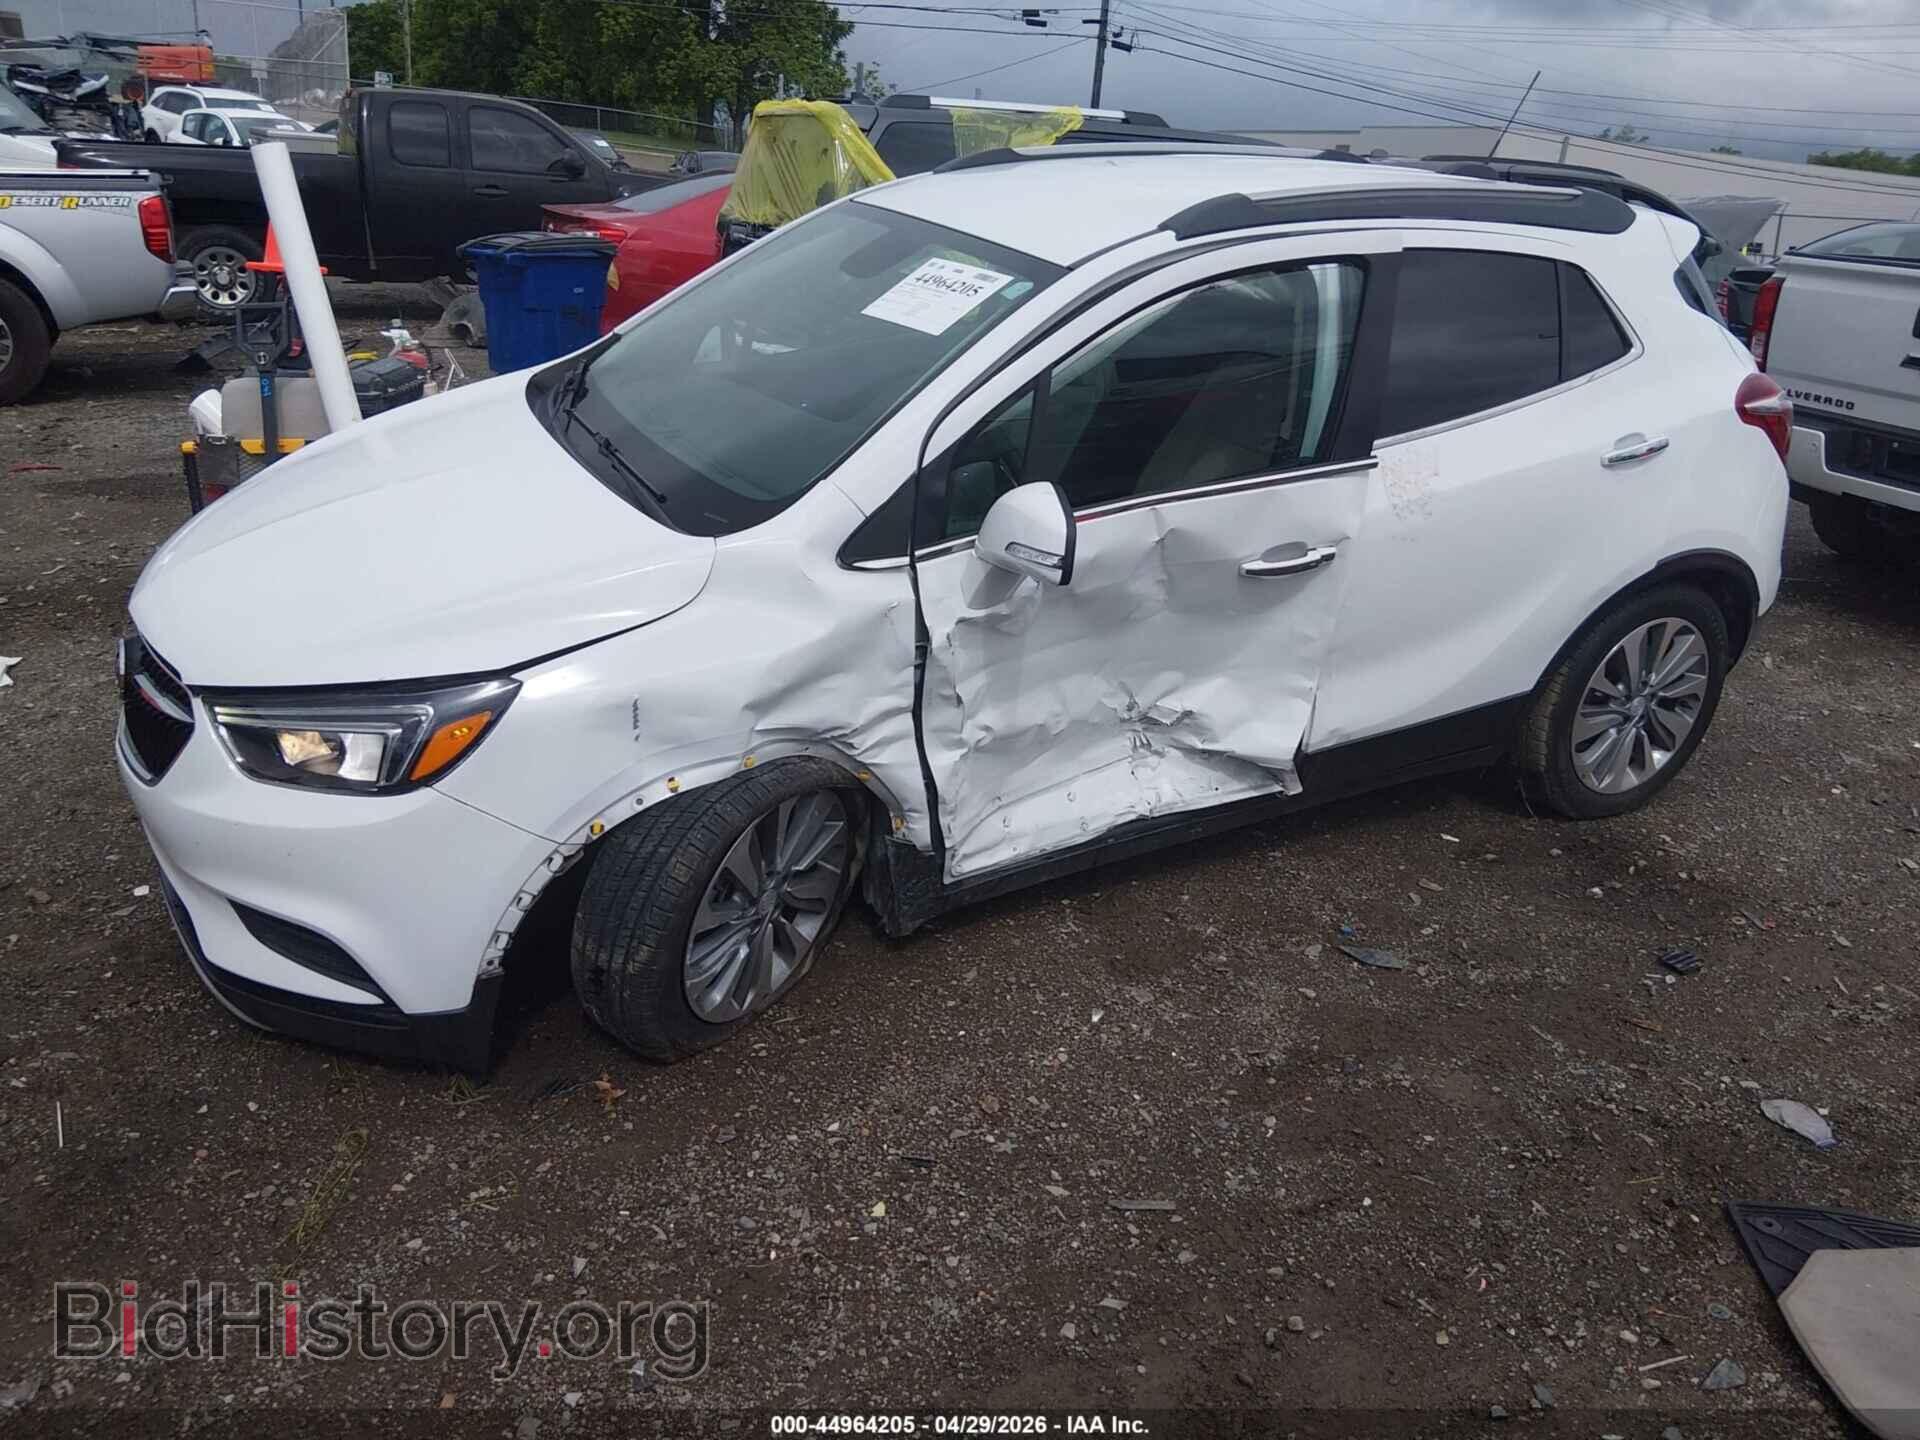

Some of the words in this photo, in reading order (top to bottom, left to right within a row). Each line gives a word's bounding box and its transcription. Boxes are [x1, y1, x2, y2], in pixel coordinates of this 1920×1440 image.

[61, 195, 131, 209] RUNNER
[914, 272, 984, 297] 44964205
[1783, 387, 1855, 410] LVERADO
